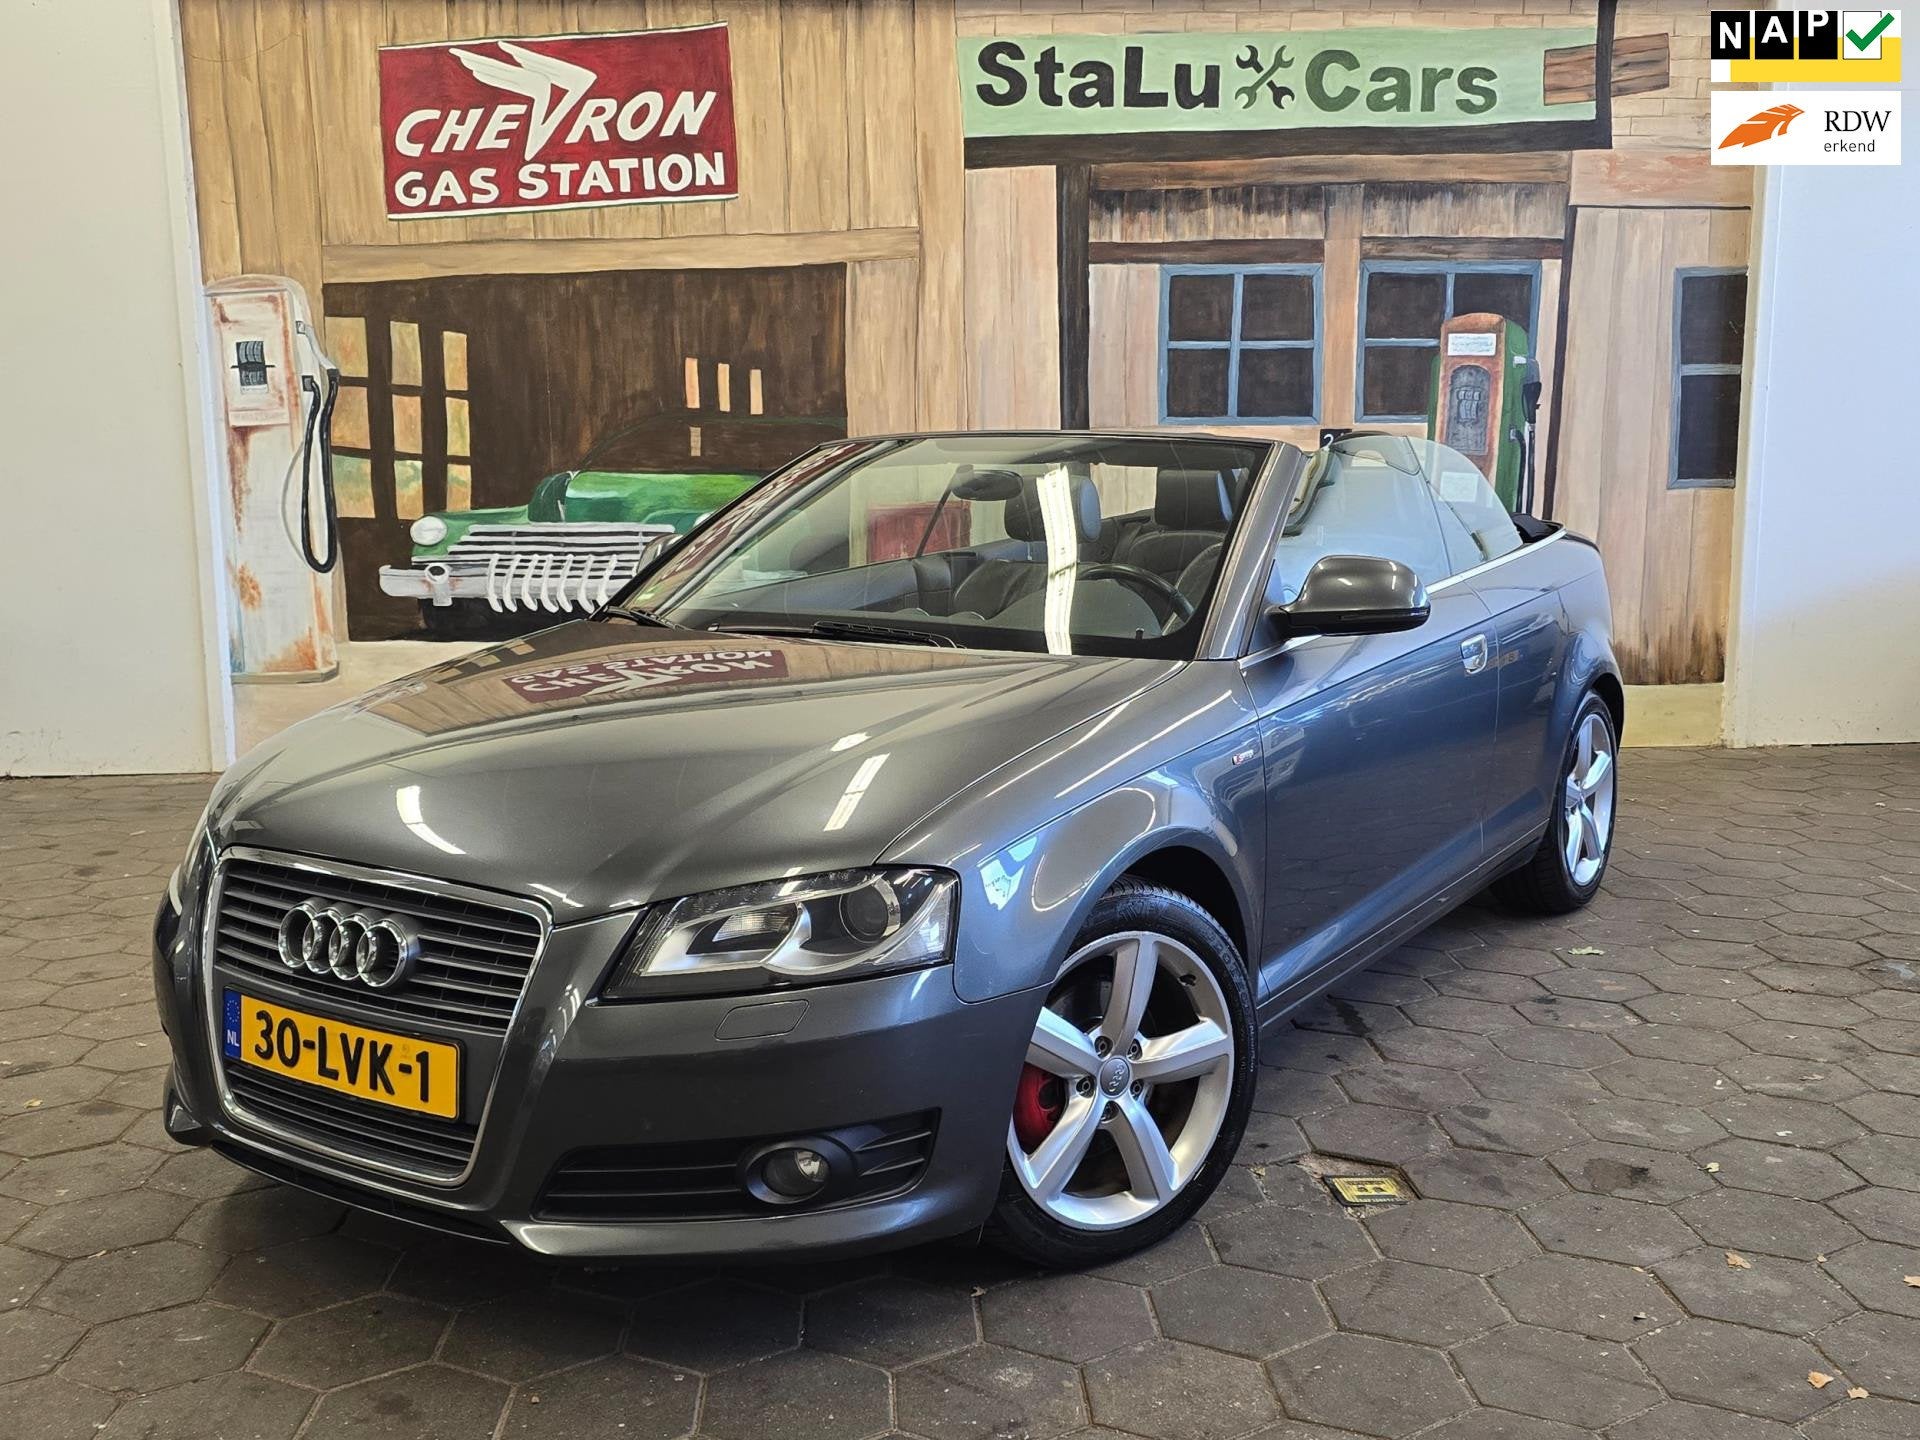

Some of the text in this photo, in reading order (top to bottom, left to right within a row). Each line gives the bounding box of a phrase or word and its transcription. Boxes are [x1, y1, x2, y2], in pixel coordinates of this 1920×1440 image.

[394, 62, 717, 161] CHEVRON
[976, 41, 1498, 115] StaLu Cars
[394, 152, 726, 208] GAS STATION
[226, 1029, 240, 1048] NL
[254, 1009, 430, 1103] 30-LVK-1
